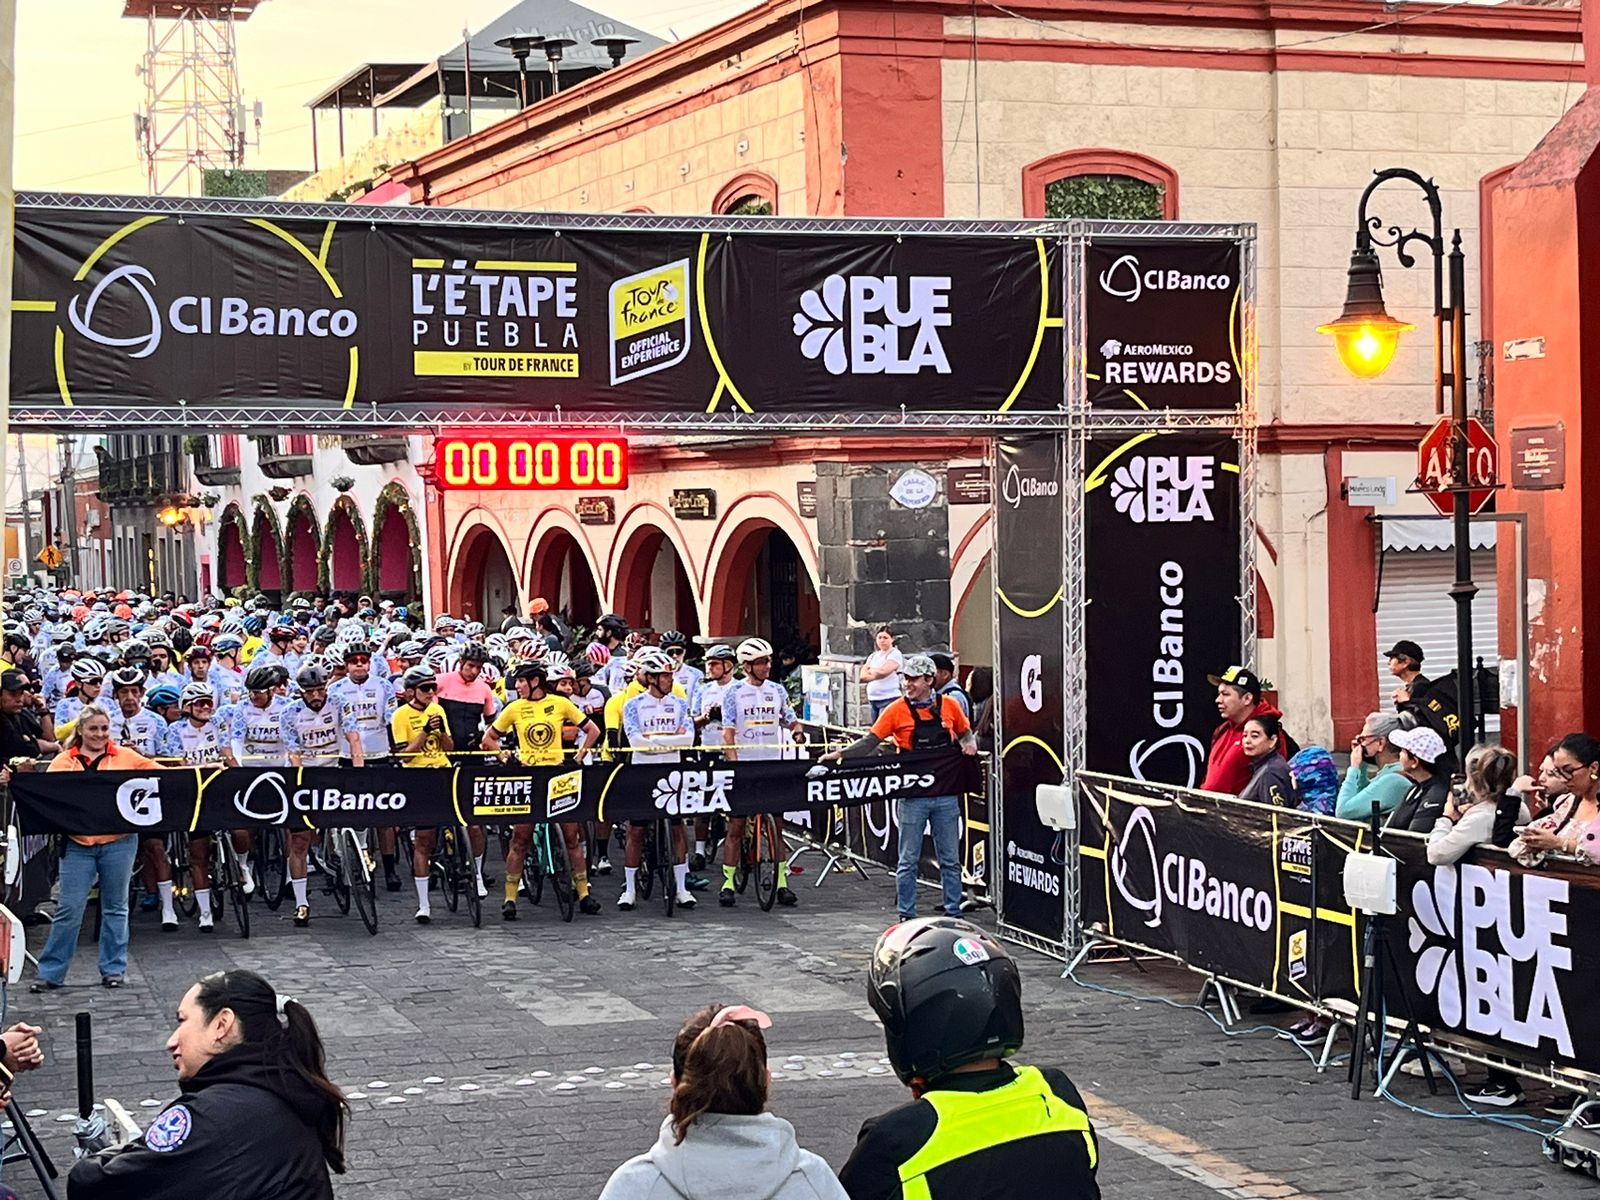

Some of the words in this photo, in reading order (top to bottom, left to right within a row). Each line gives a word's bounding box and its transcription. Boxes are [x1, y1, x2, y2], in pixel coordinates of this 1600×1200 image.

[413, 320, 578, 349] PUEBLA
[629, 331, 672, 354] OFFICIAL
[474, 357, 506, 372] TOUR
[508, 357, 525, 371] DE
[526, 358, 574, 373] FRANCE
[621, 339, 680, 369] EXPERIENCE
[1105, 361, 1232, 384] REWARDS
[473, 795, 531, 805] PUEBLA
[1009, 861, 1060, 896] REWARDS
